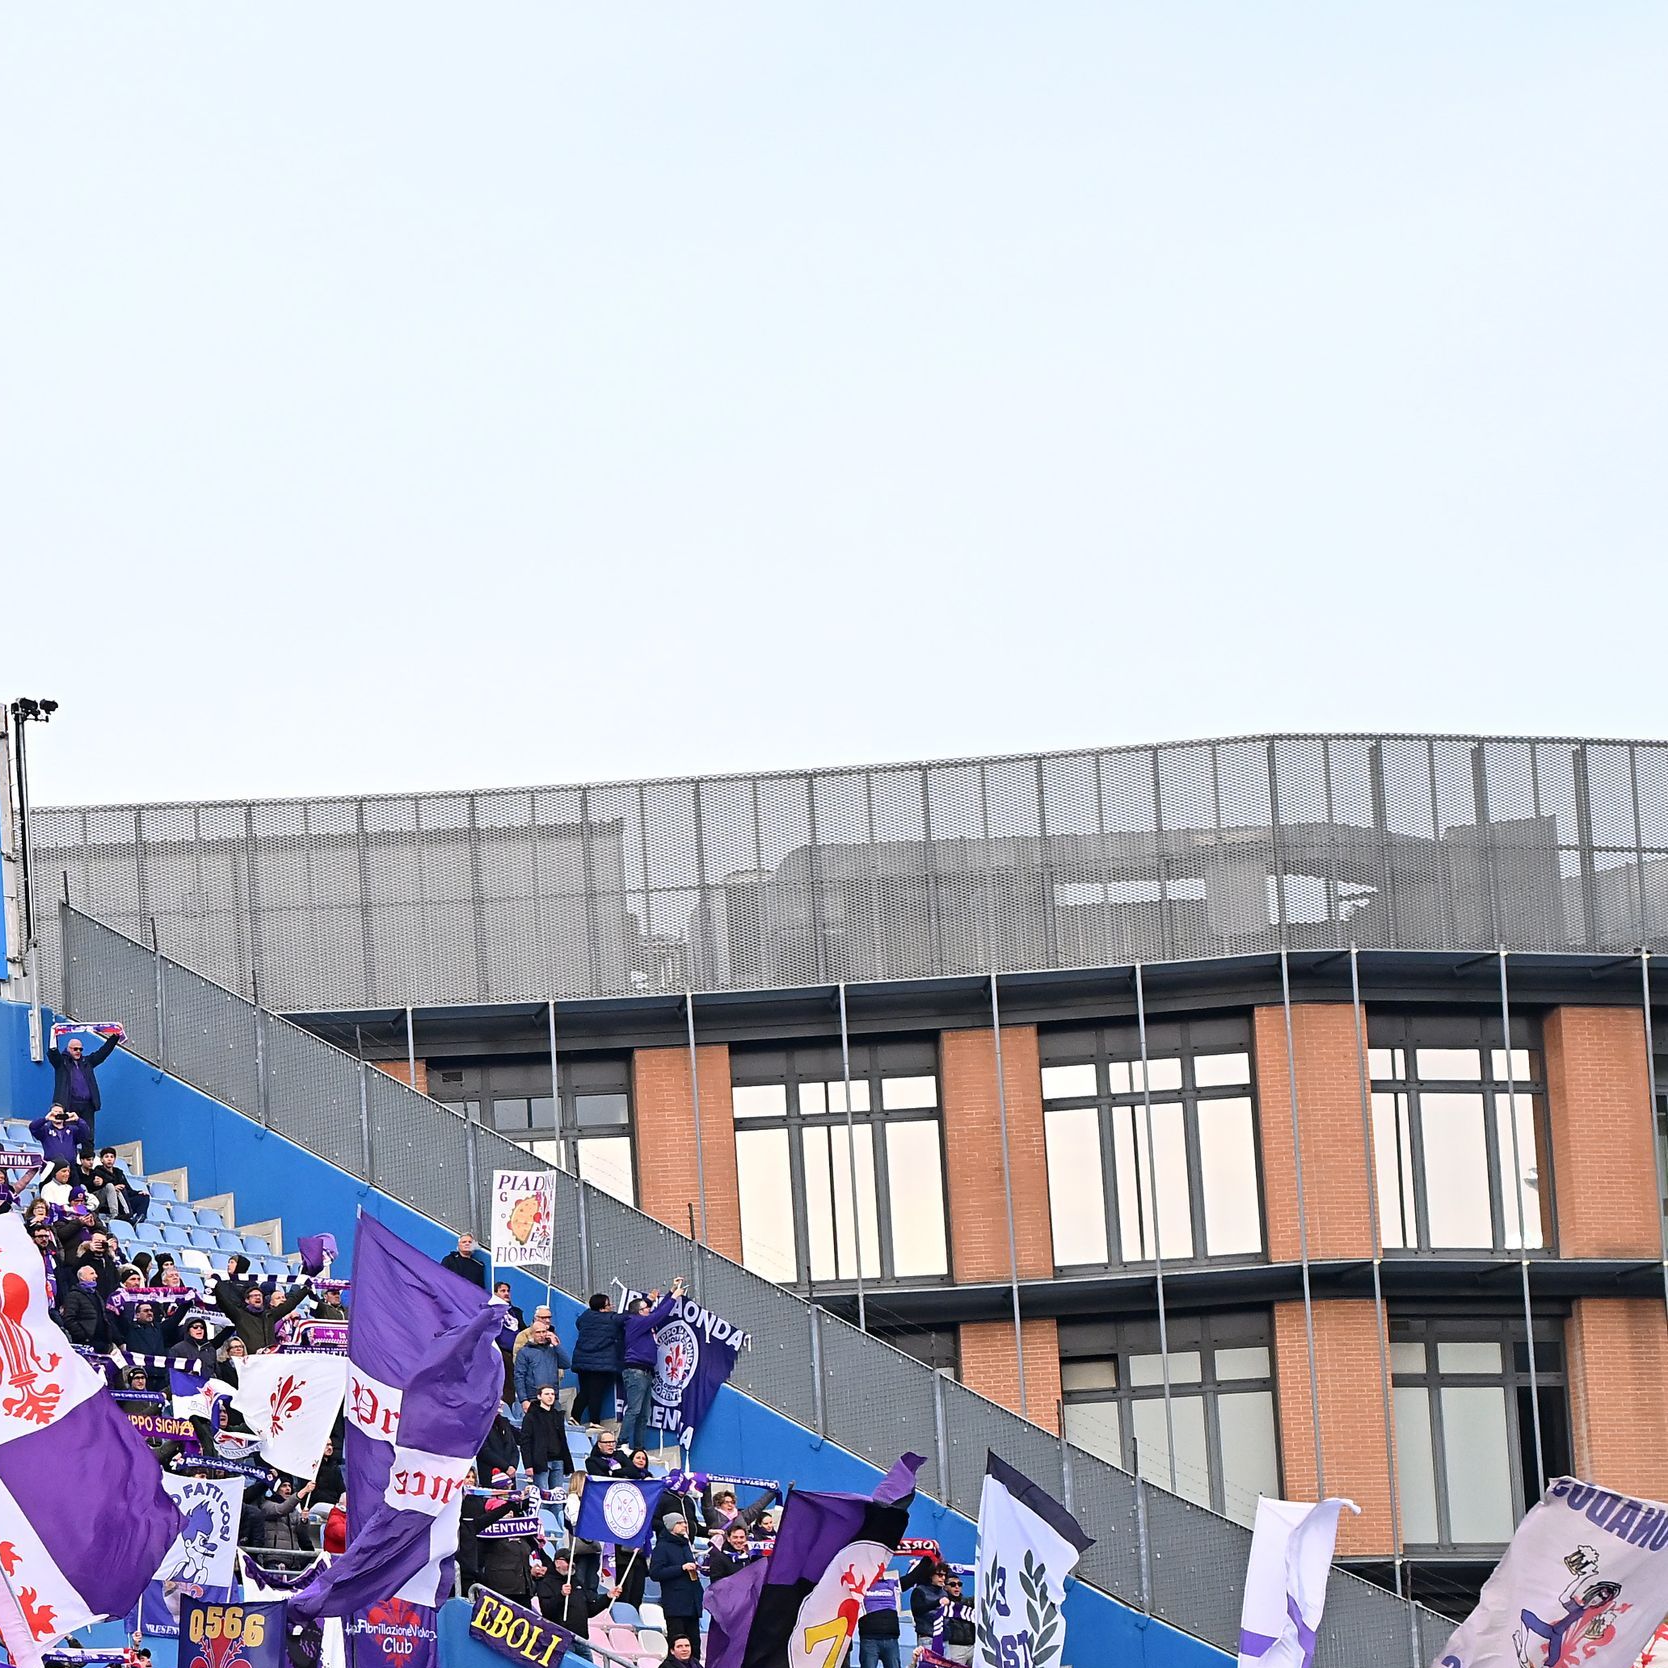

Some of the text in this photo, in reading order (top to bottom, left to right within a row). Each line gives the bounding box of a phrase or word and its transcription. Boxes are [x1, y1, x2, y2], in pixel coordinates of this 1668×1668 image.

[183, 1482, 224, 1501] FATTI
[190, 1606, 265, 1647] 0566
[469, 1595, 563, 1668] EBOLI
[383, 1637, 413, 1654] Club
